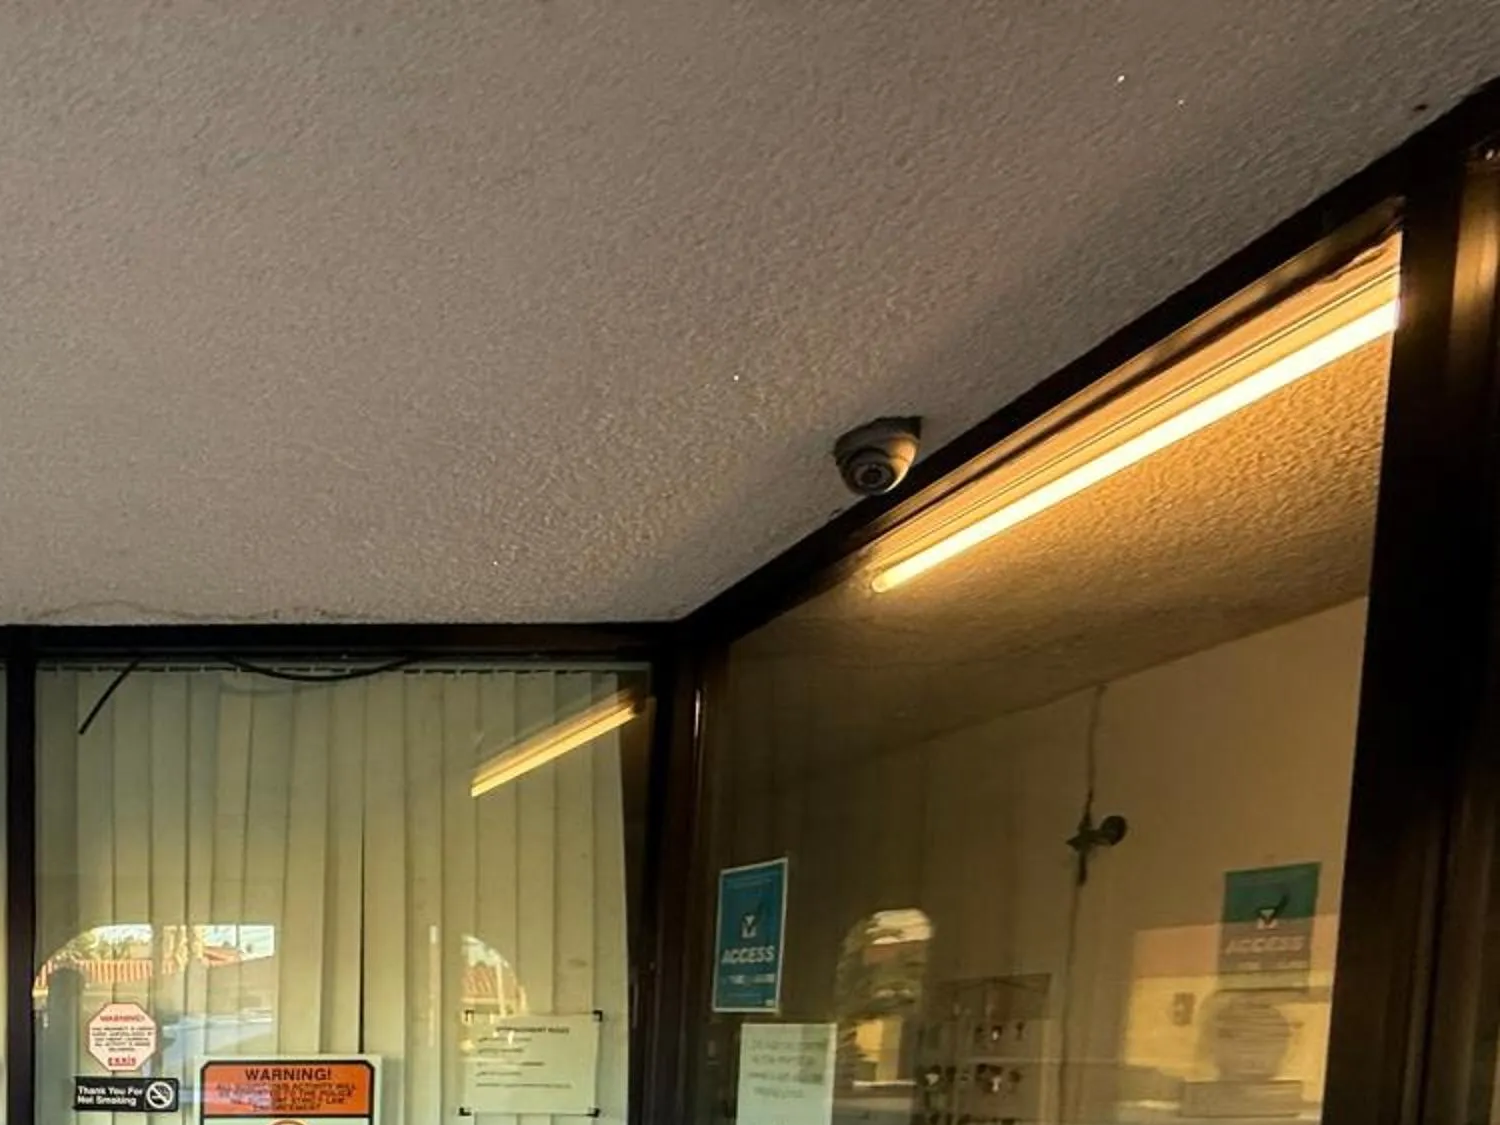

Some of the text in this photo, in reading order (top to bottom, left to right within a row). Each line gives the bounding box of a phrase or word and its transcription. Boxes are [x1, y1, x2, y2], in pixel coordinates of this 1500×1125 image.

[721, 945, 775, 965] ACCESS
[244, 1067, 332, 1081] WARNING!
[77, 1085, 144, 1095] Thank You For
[77, 1096, 137, 1107] Not Smoking
